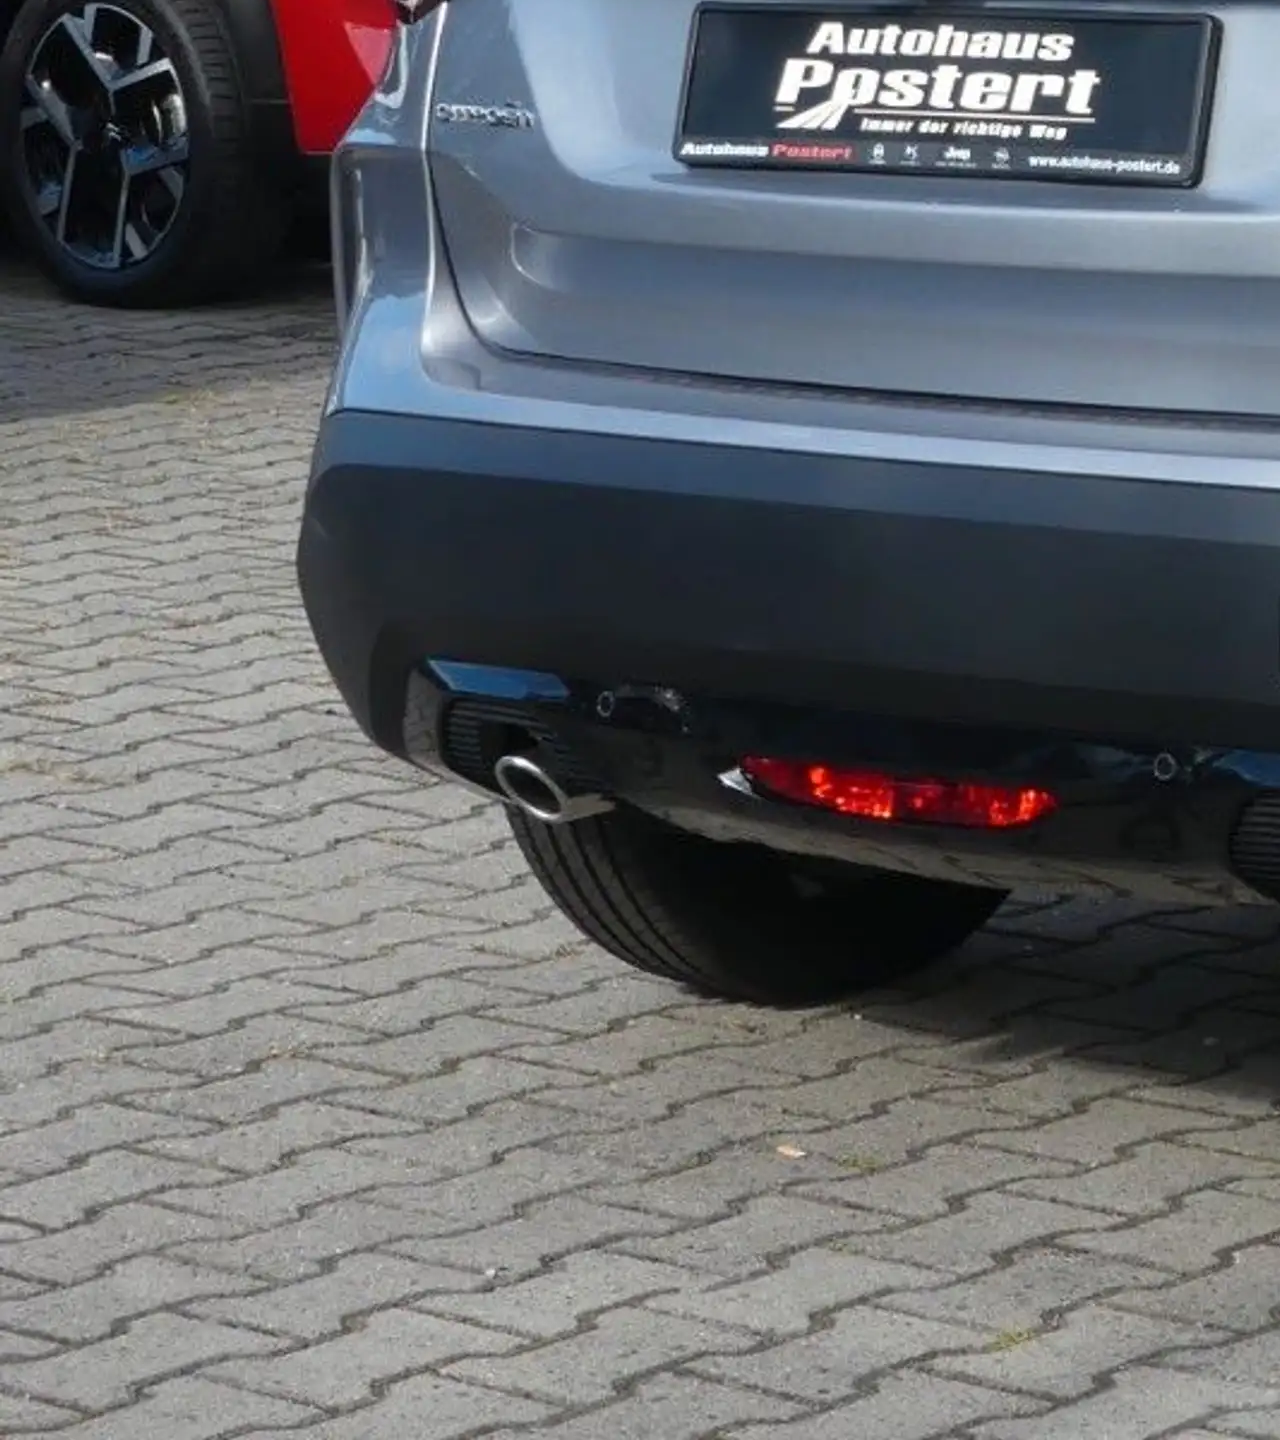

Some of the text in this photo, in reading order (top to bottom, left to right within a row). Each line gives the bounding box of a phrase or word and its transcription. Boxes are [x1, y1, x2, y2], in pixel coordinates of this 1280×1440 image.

[806, 21, 1075, 61] Autohaus
[774, 58, 1100, 114] Postert
[918, 119, 949, 135] der
[953, 120, 1024, 140] richtige
[1029, 123, 1069, 142] Weg
[680, 142, 853, 160] Autohaus Postert
